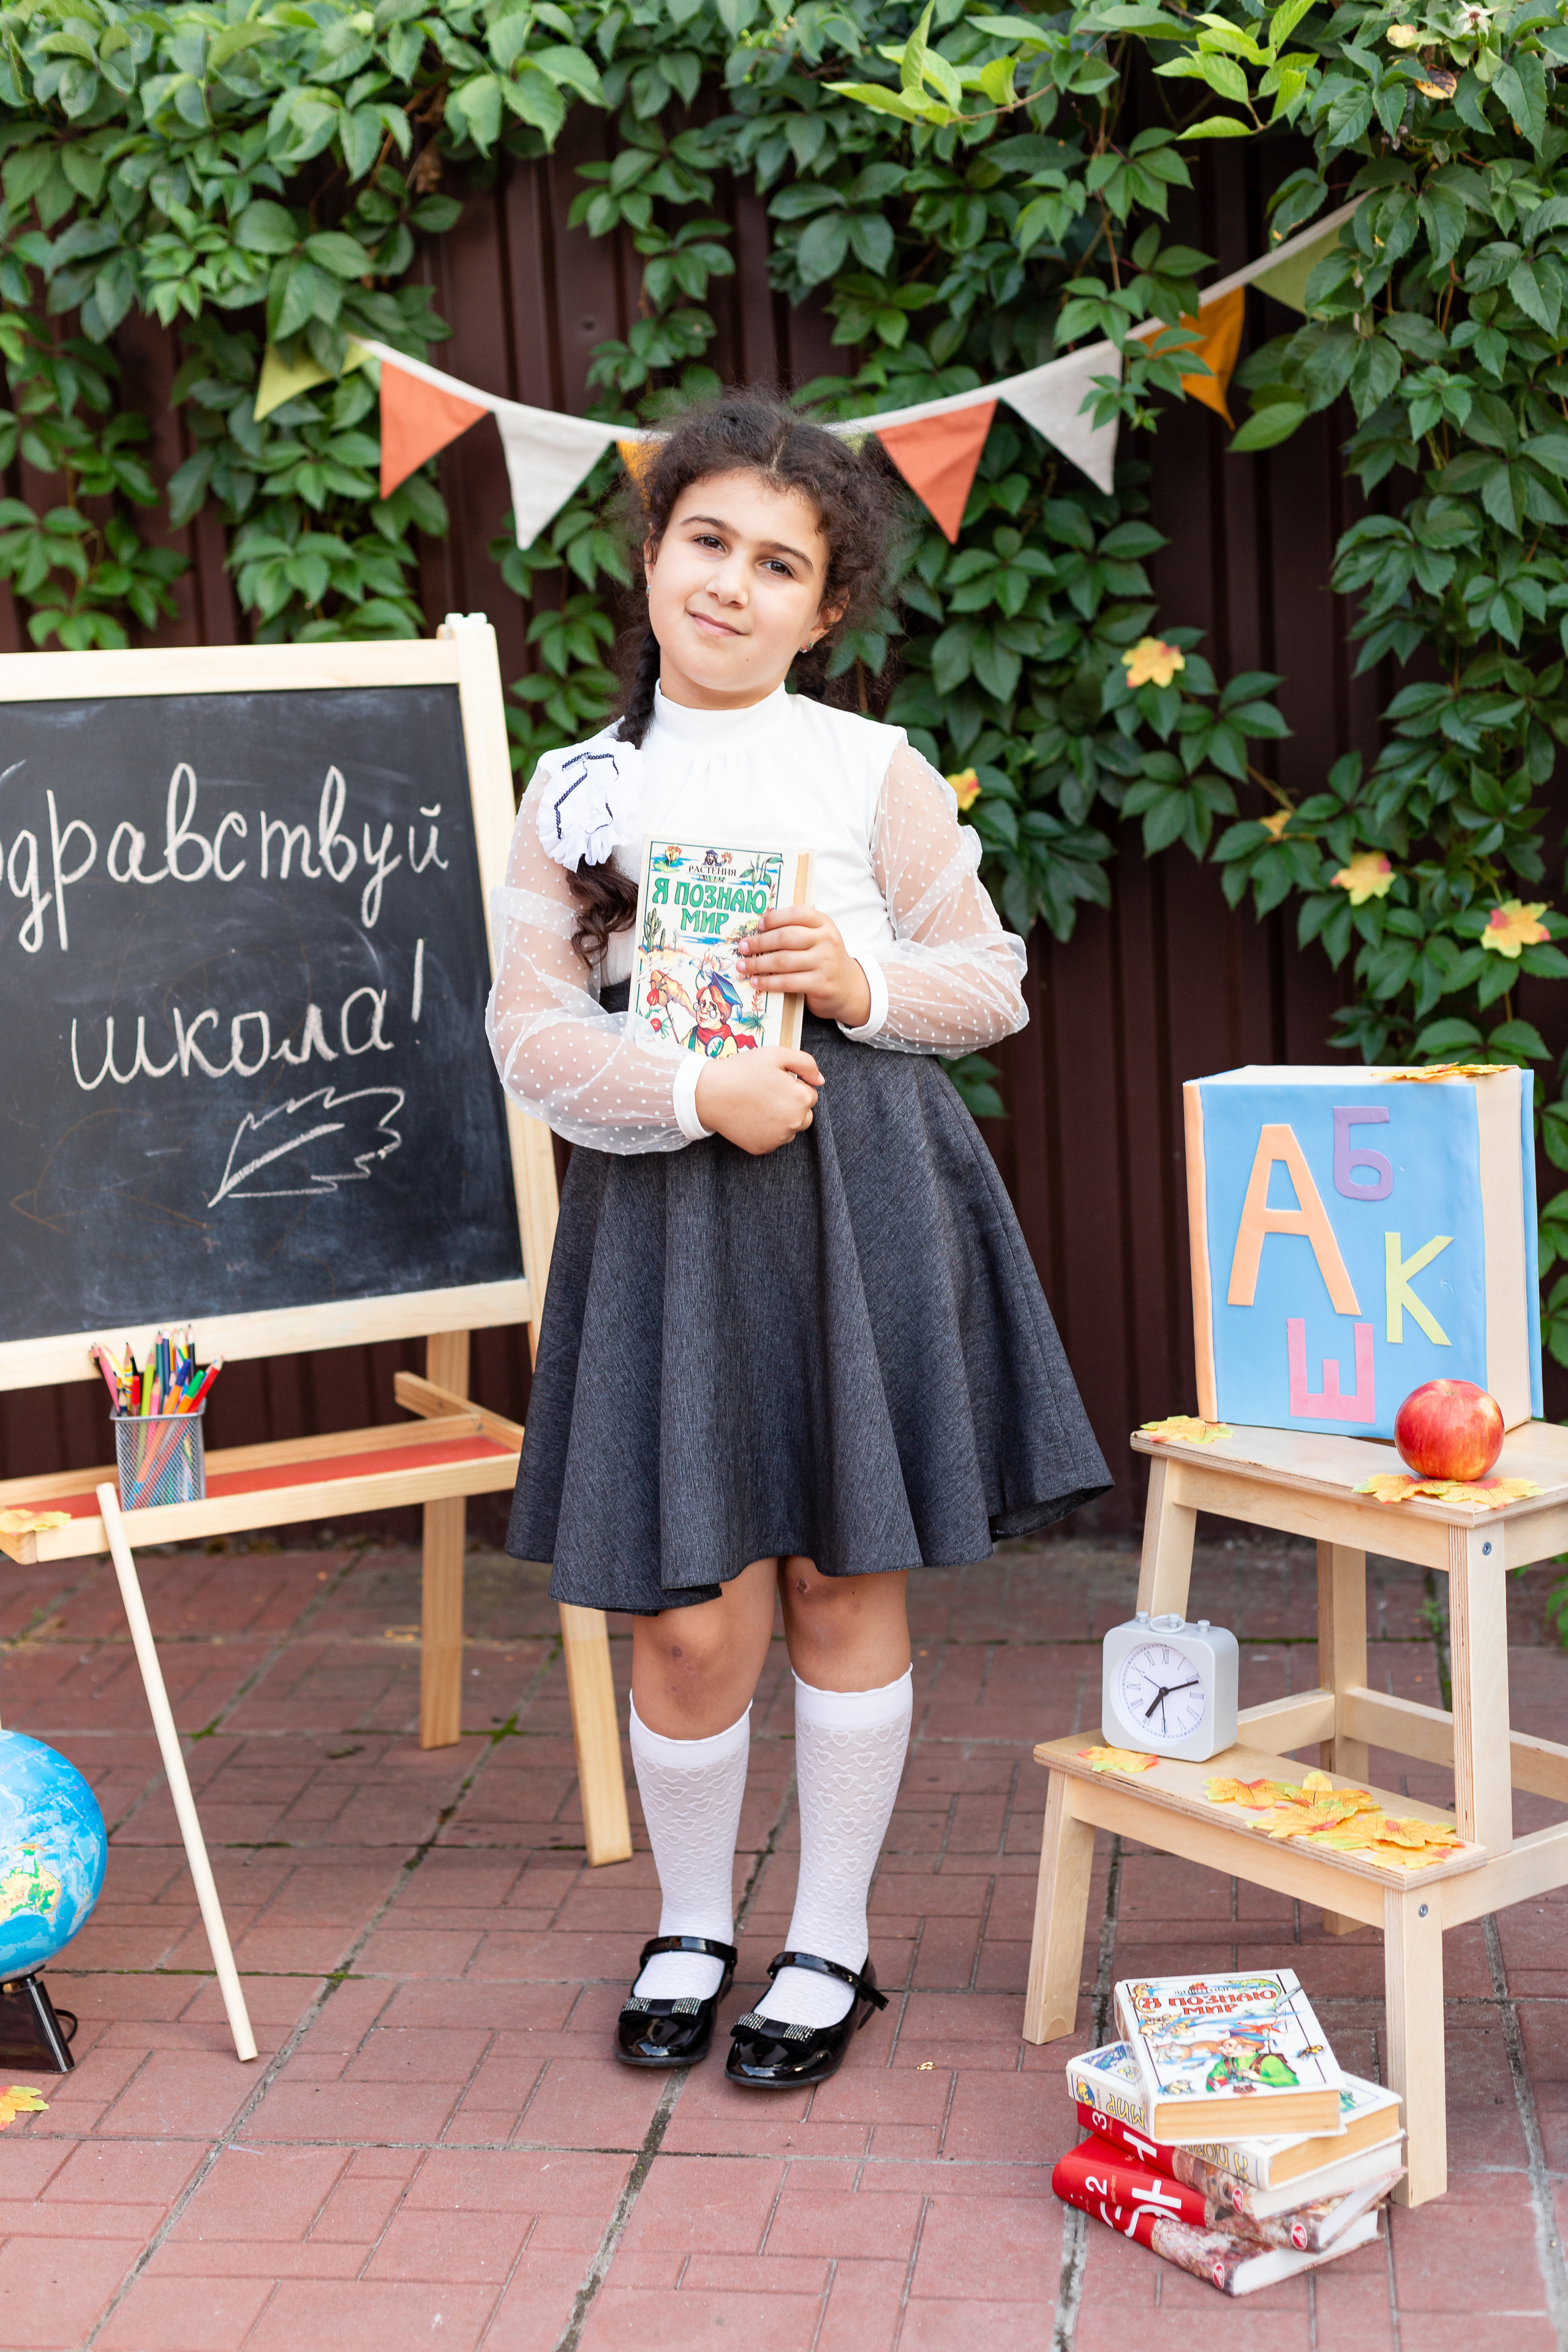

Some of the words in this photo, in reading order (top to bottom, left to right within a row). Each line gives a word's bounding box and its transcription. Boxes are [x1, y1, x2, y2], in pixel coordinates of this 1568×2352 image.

[0, 762, 450, 953] дравствуй
[688, 864, 737, 877] РАСТЕНИЯ
[652, 877, 671, 905] Я
[674, 881, 767, 914] ПОЗНАЮ
[680, 907, 729, 935] МИР
[70, 938, 424, 1090] школа!
[1333, 1106, 1393, 1201] Б
[1227, 1123, 1362, 1316] А
[1384, 1231, 1454, 1347] К
[1286, 1317, 1376, 1424] Ш
[1142, 1997, 1162, 2009] Я
[1168, 1989, 1277, 2007] ПОЗНАЮ
[1183, 2003, 1238, 2015] МИР
[1091, 2111, 1107, 2131] 3
[1105, 2092, 1147, 2131] МИР
[1085, 2176, 1107, 2196] 2
